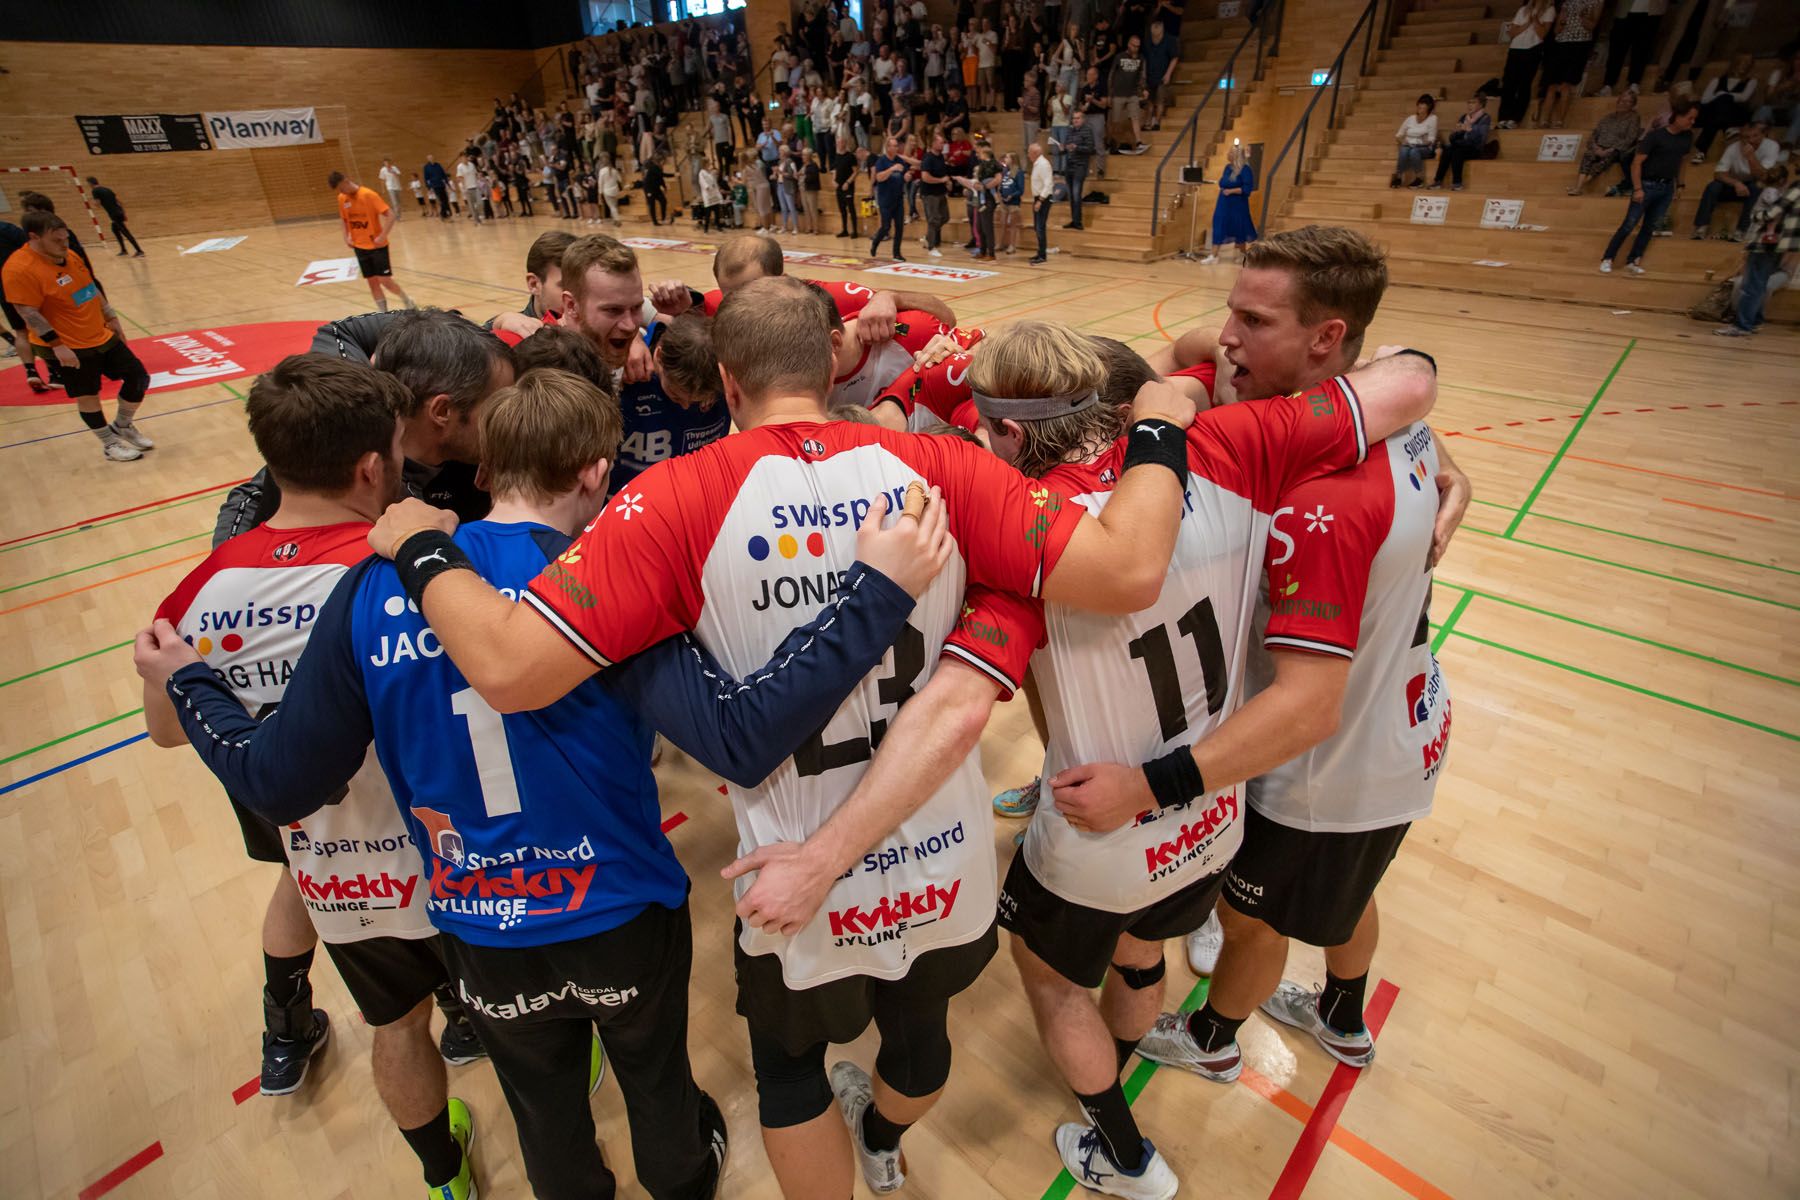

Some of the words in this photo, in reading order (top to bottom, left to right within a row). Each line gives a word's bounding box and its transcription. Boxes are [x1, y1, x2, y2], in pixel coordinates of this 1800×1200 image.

[122, 118, 166, 135] MAXX
[210, 116, 315, 139] Planway
[1128, 596, 1229, 744] 11
[451, 686, 521, 818] 1
[1145, 783, 1238, 874] Kvickly
[298, 869, 419, 909] Kvickly
[429, 857, 598, 912] Kvickly
[828, 879, 961, 936] Kvickly
